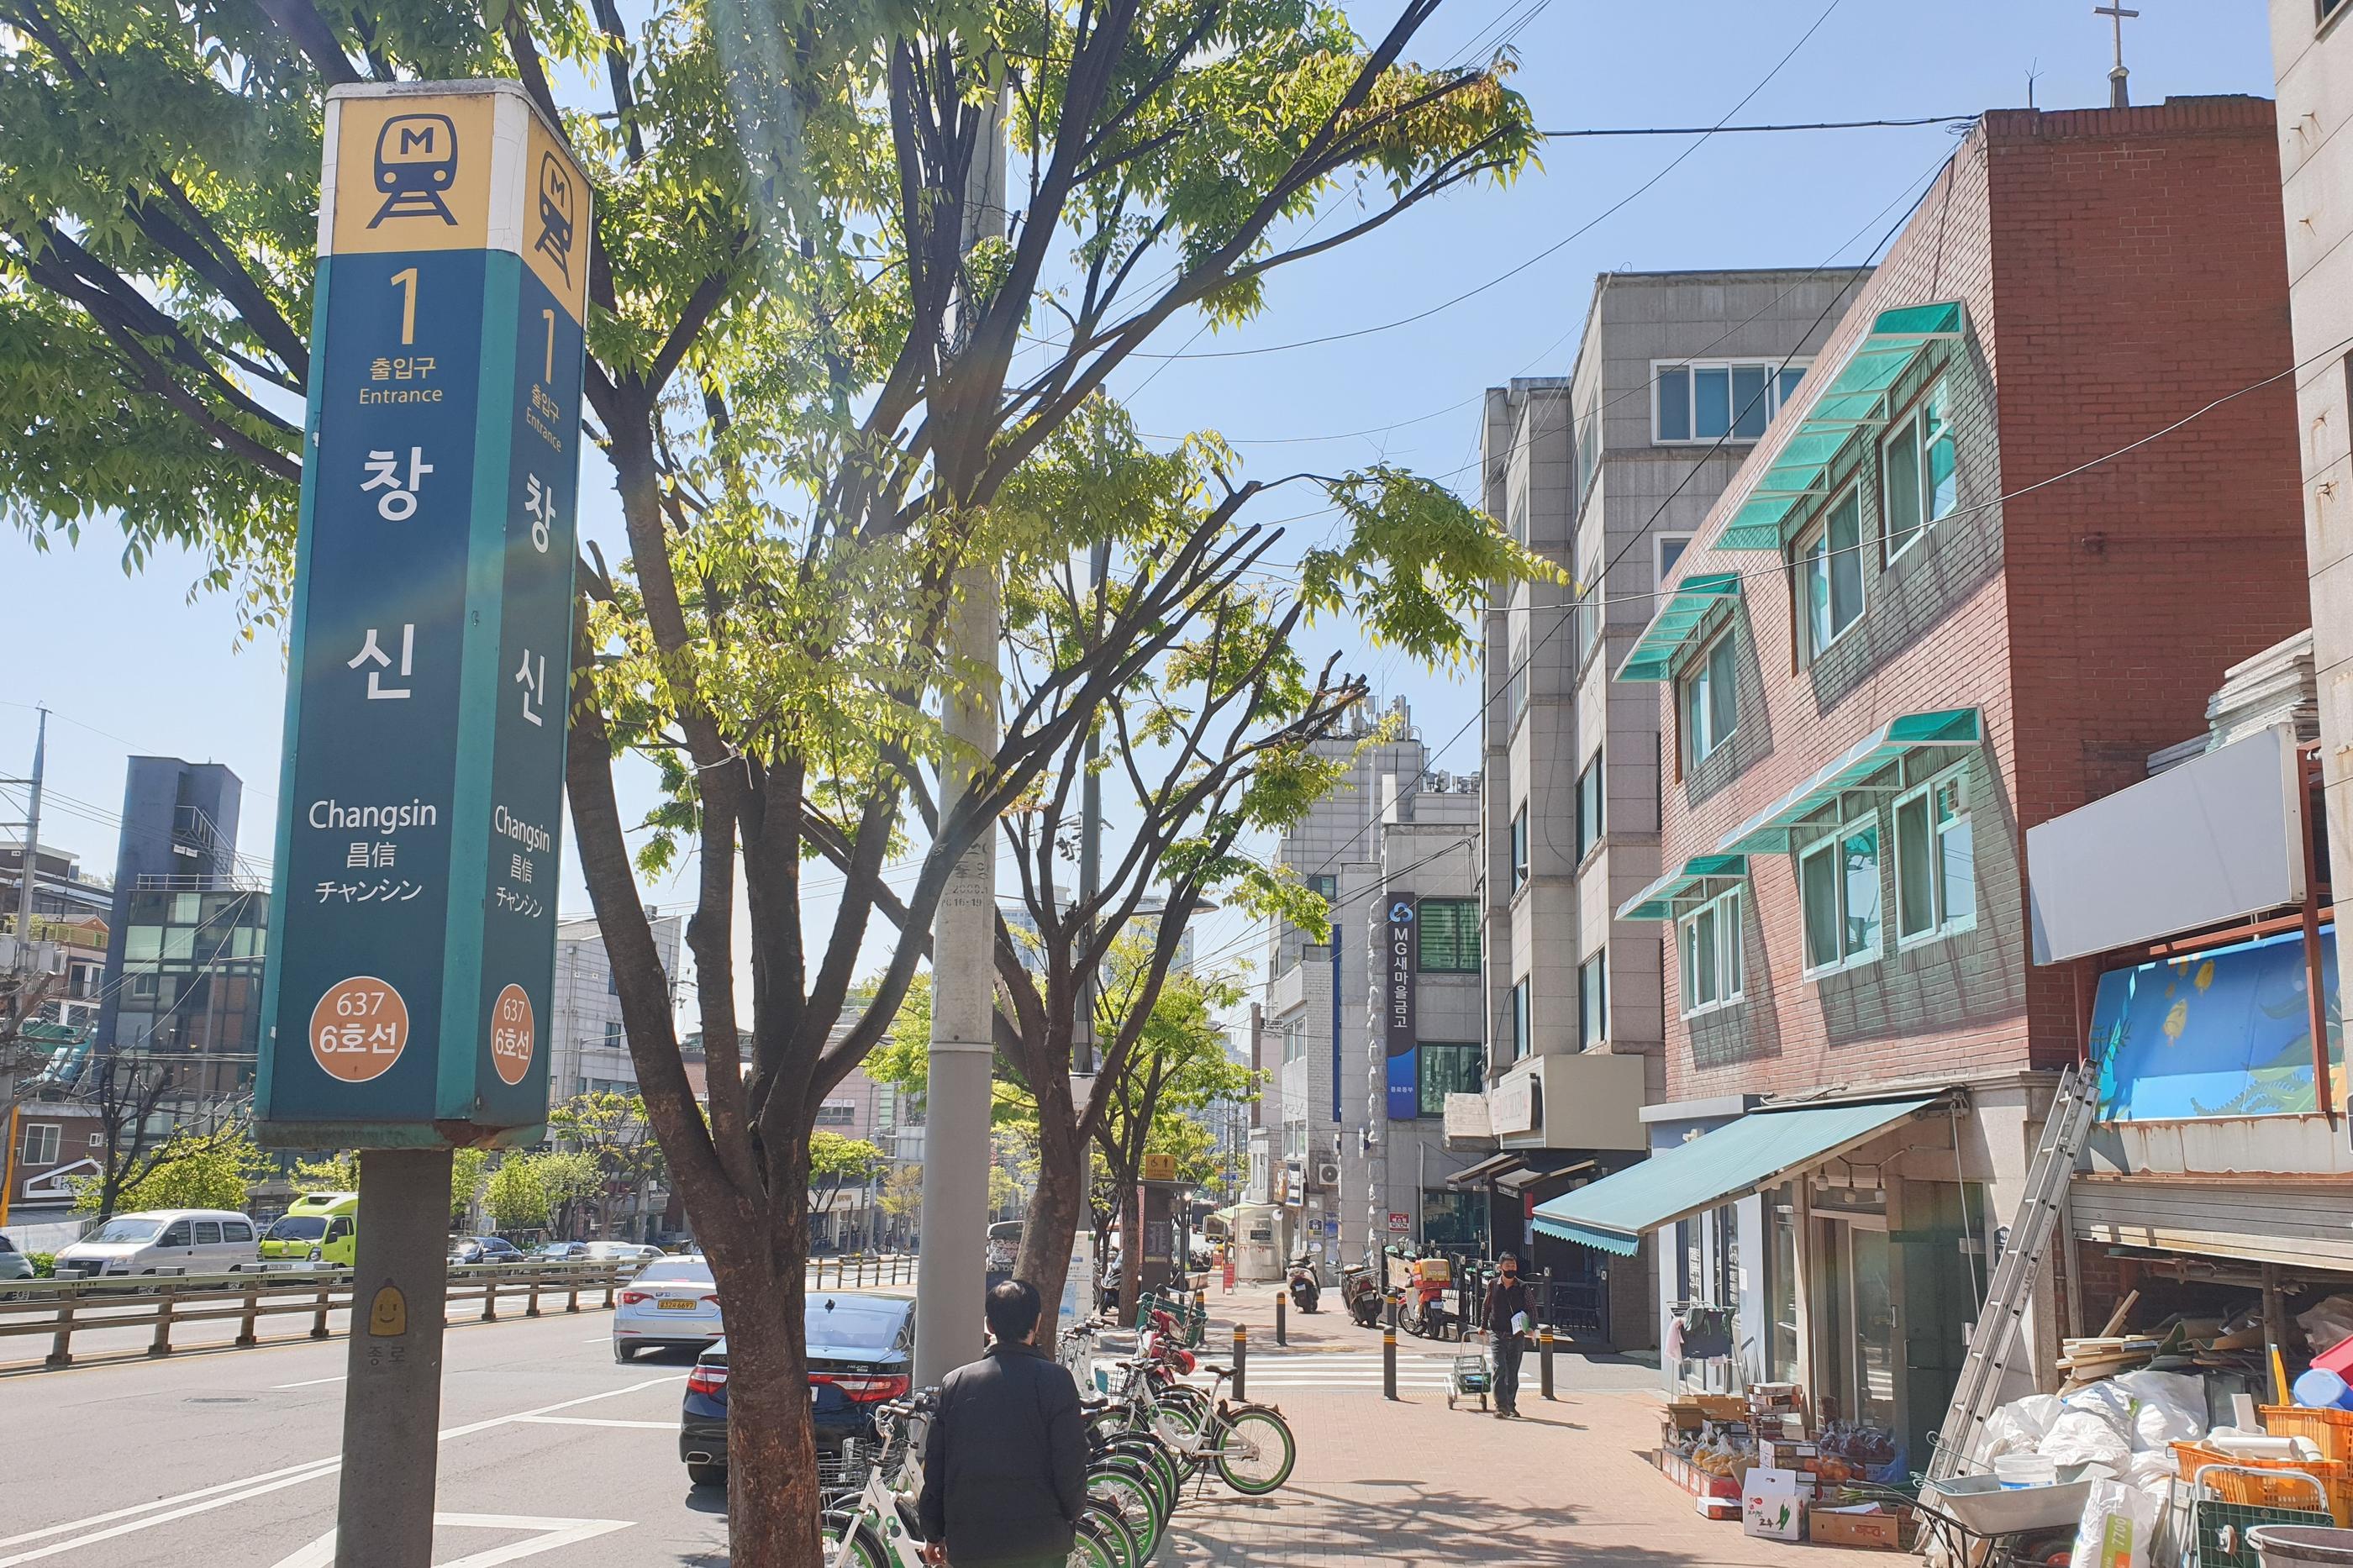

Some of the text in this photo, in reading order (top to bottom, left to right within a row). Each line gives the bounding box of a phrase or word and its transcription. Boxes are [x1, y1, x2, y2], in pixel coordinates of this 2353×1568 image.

[400, 126, 434, 155] M
[550, 168, 566, 207] M
[390, 267, 418, 345] 1
[542, 308, 555, 384] 1
[369, 357, 436, 381] 출입구
[359, 387, 443, 405] Entrance
[531, 384, 560, 421] 출입구
[526, 407, 561, 453] Entrance
[308, 798, 437, 835] Changsin
[495, 804, 550, 853] Changsin
[346, 842, 397, 869] 昌信
[510, 853, 534, 884] 昌信
[314, 879, 423, 903] チャンシン
[496, 885, 543, 918] チャンシン
[1393, 927, 1408, 1028] MG새마을금고
[337, 992, 386, 1016] 637
[504, 998, 525, 1023] 637
[319, 1023, 397, 1055] 6호선
[495, 1029, 529, 1061] 6호선
[368, 1346, 405, 1366] 종로
